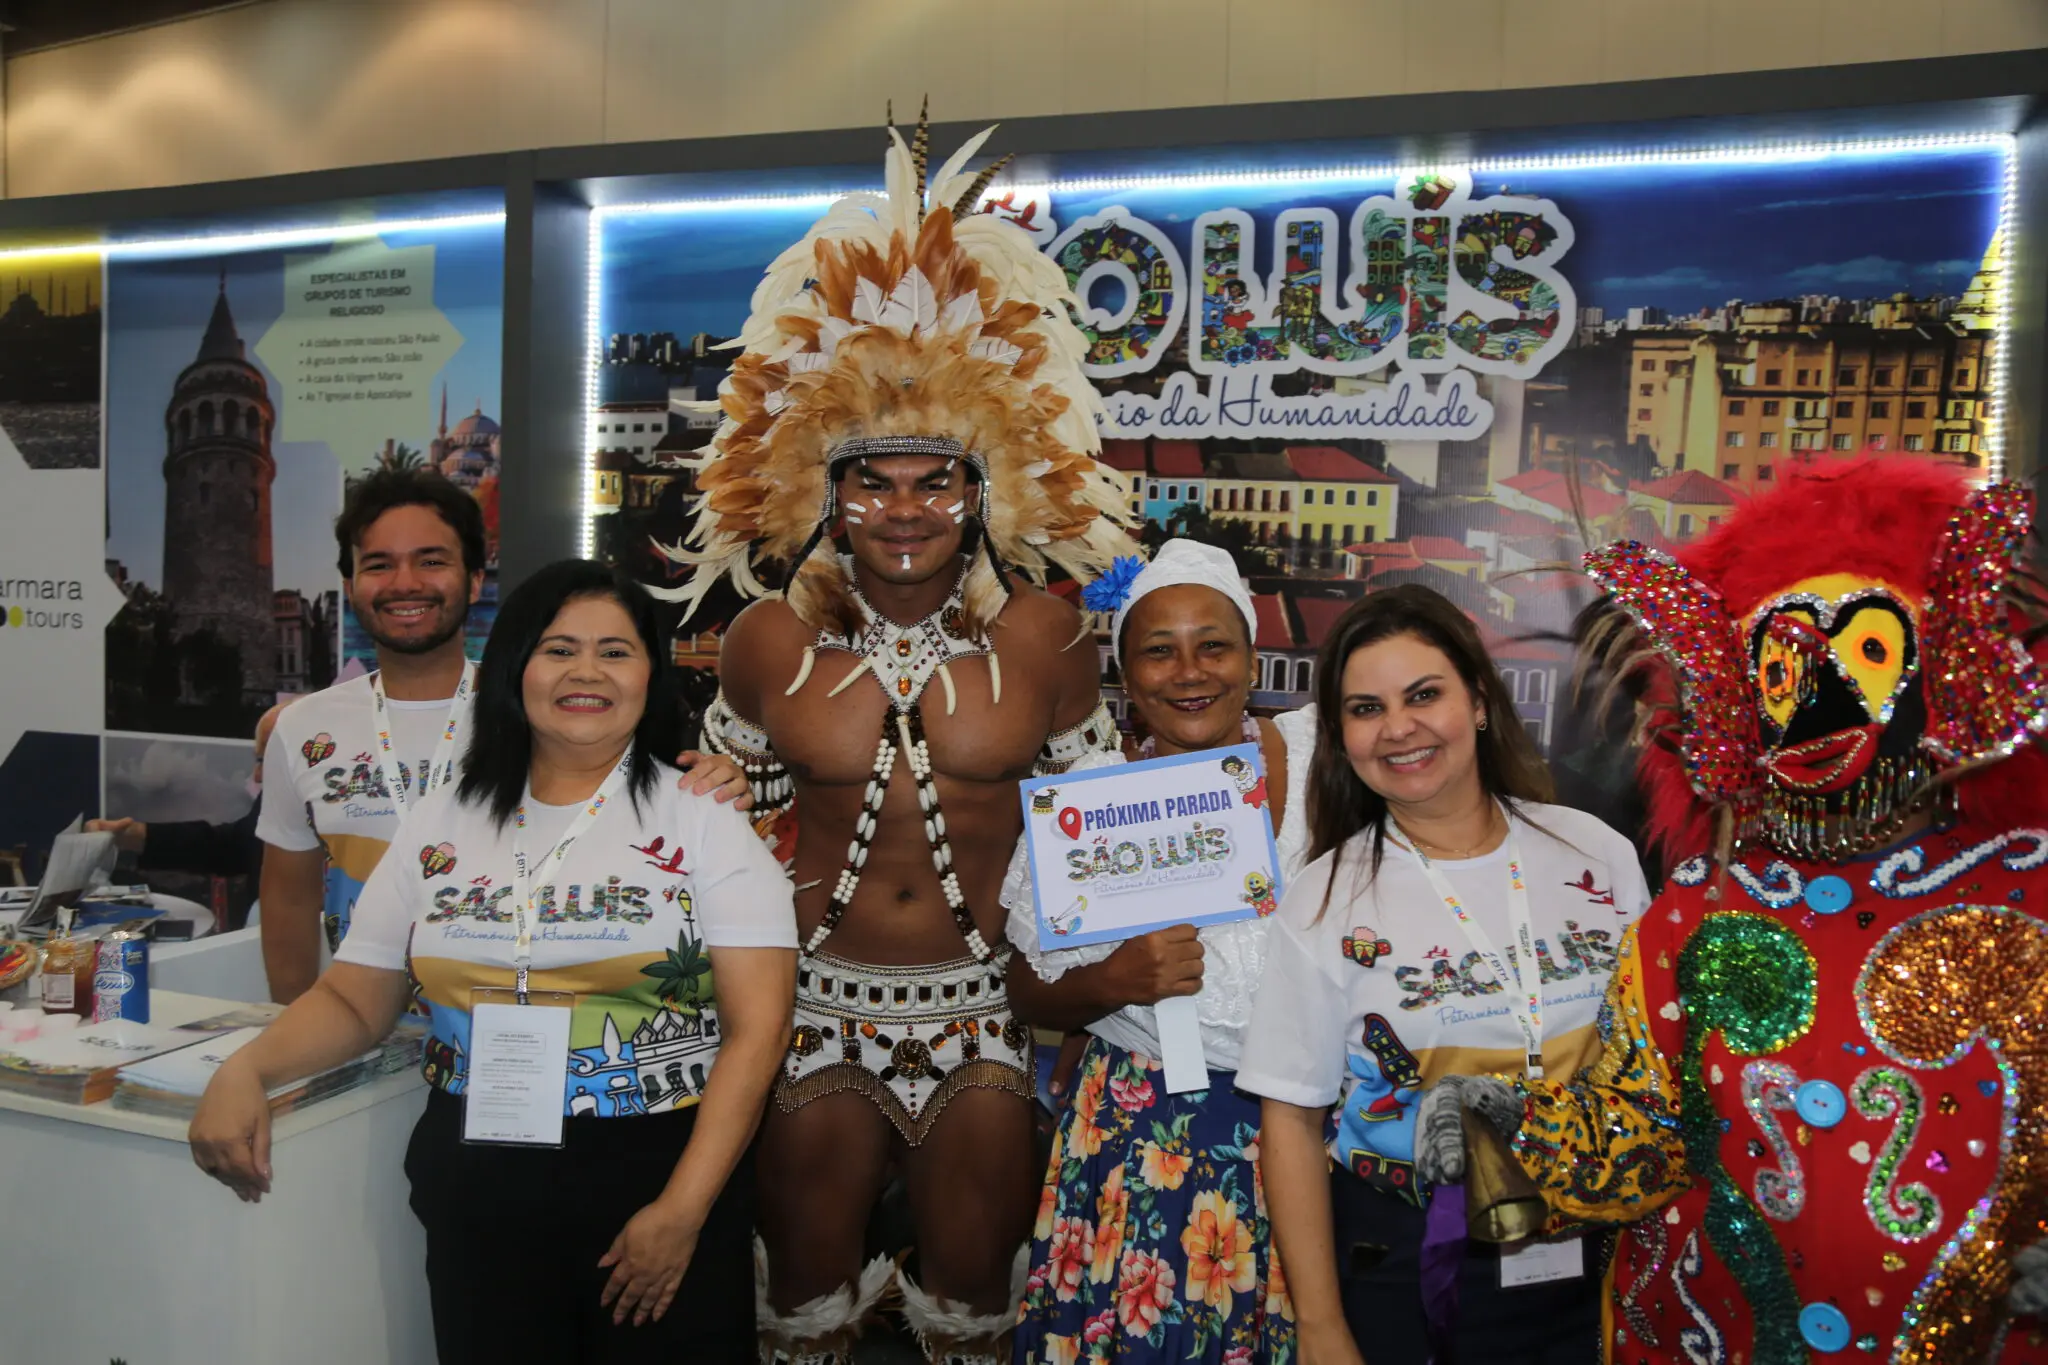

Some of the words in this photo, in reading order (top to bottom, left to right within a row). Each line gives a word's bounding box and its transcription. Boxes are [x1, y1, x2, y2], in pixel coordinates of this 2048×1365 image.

[310, 269, 388, 284] ESPECIALISTAS
[390, 268, 406, 280] EM
[304, 287, 347, 302] GRUPOS
[349, 288, 363, 300] DE
[365, 285, 411, 298] TURISMO
[329, 304, 385, 317] RELIGIOSO
[1160, 384, 1211, 426] da
[1218, 374, 1478, 428] Humanidade
[26, 607, 83, 629] tours
[1084, 801, 1161, 831] PRÓXIMA
[1165, 789, 1232, 819] PARADA
